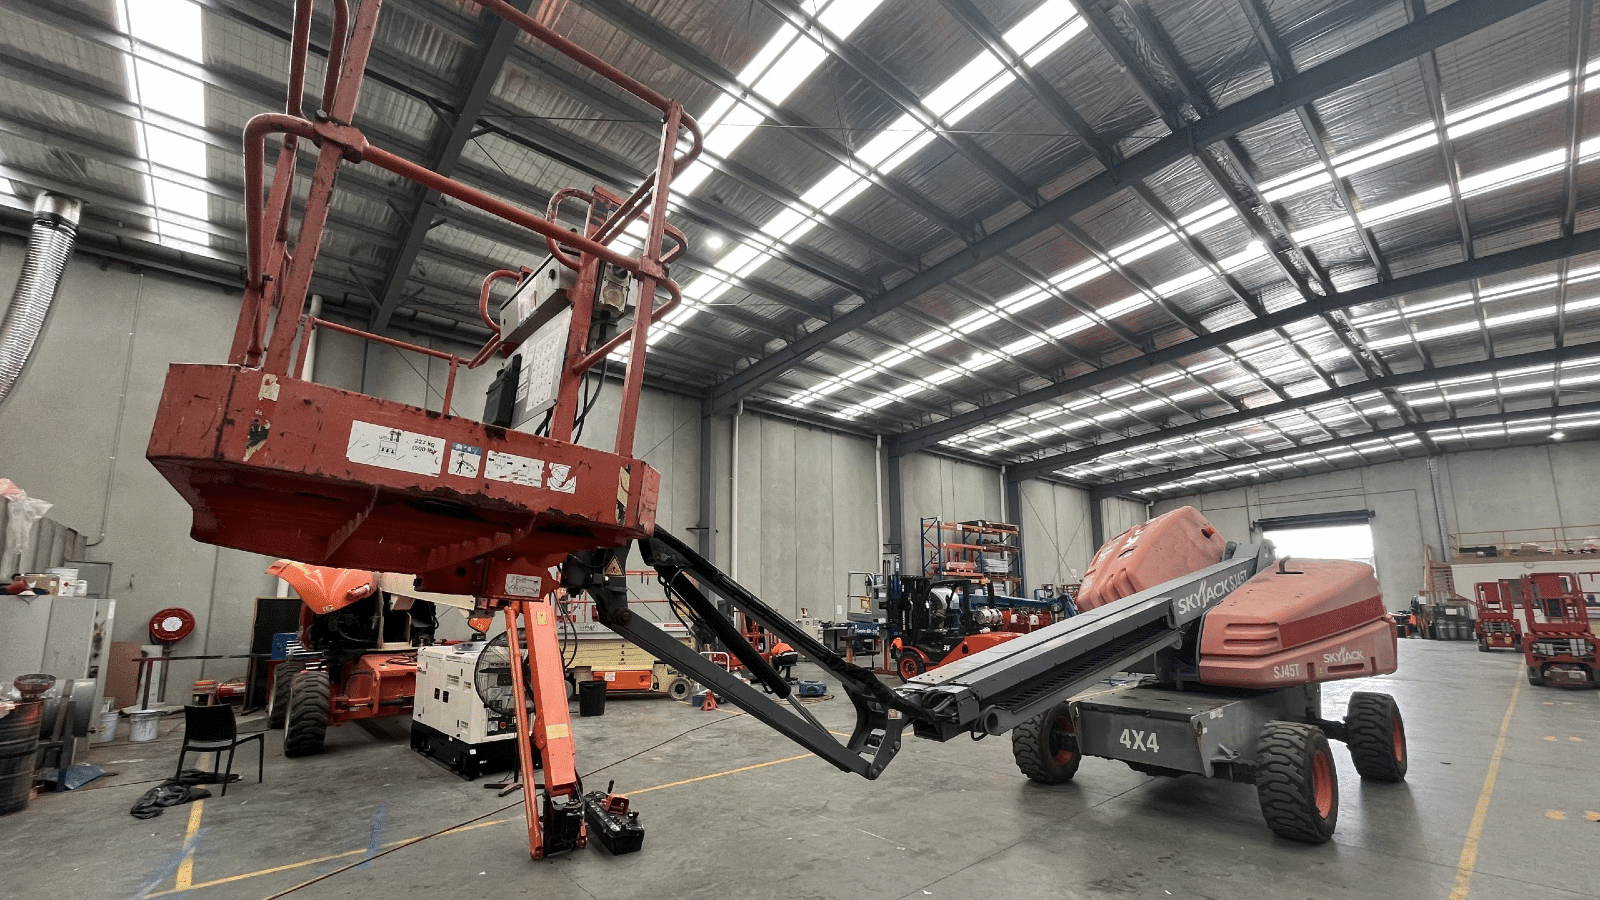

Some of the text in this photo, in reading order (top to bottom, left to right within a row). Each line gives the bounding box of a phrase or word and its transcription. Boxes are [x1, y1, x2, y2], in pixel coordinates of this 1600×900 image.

[1178, 579, 1231, 615] SKYJACK
[1323, 646, 1365, 664] SKYJACK
[1273, 663, 1300, 679] SJ45T
[1119, 728, 1160, 753] 4X4
